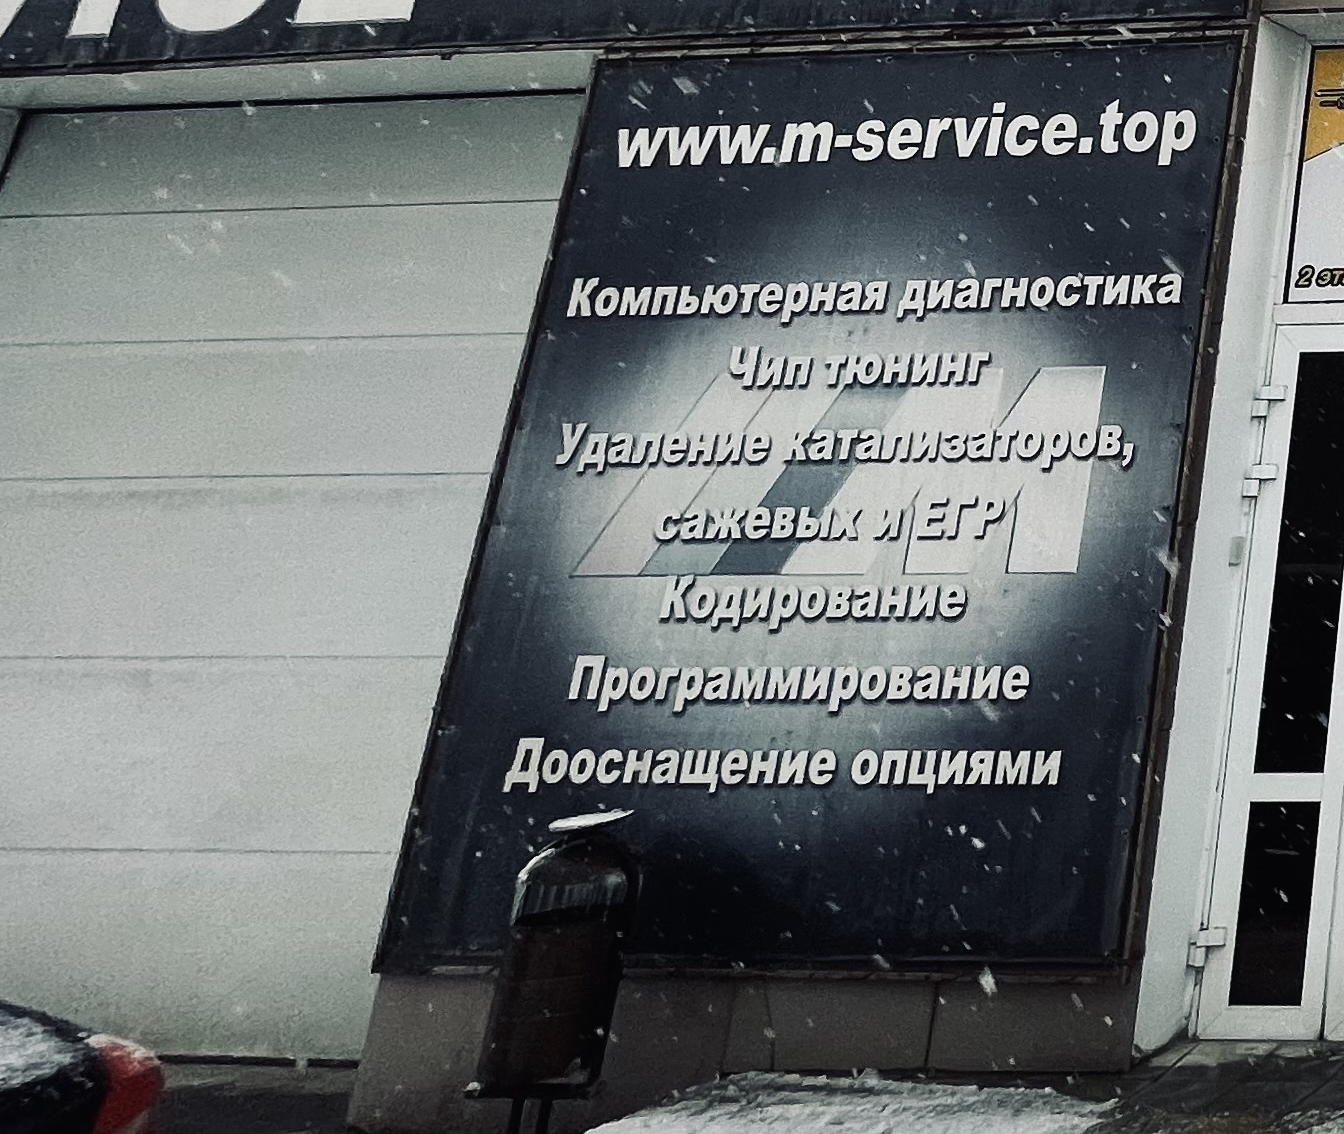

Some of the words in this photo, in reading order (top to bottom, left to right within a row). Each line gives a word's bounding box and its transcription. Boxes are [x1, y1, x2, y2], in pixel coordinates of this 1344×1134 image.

[618, 98, 1197, 167] www.m-service.top
[567, 277, 886, 322] Компьютерная
[897, 272, 1182, 318] диагностика
[1295, 264, 1315, 288] 2
[728, 346, 811, 390] Чип
[825, 350, 992, 387] тюнинг
[556, 423, 771, 472] Удаление
[783, 423, 1135, 469] катализаторов,
[655, 503, 860, 542] сажевых
[873, 507, 902, 539] и
[916, 496, 1006, 539] ЕГР
[659, 577, 968, 629] Кодирование
[568, 655, 1031, 712] Программирование
[503, 737, 834, 792] Дооснащение
[850, 747, 1061, 792] опциями
